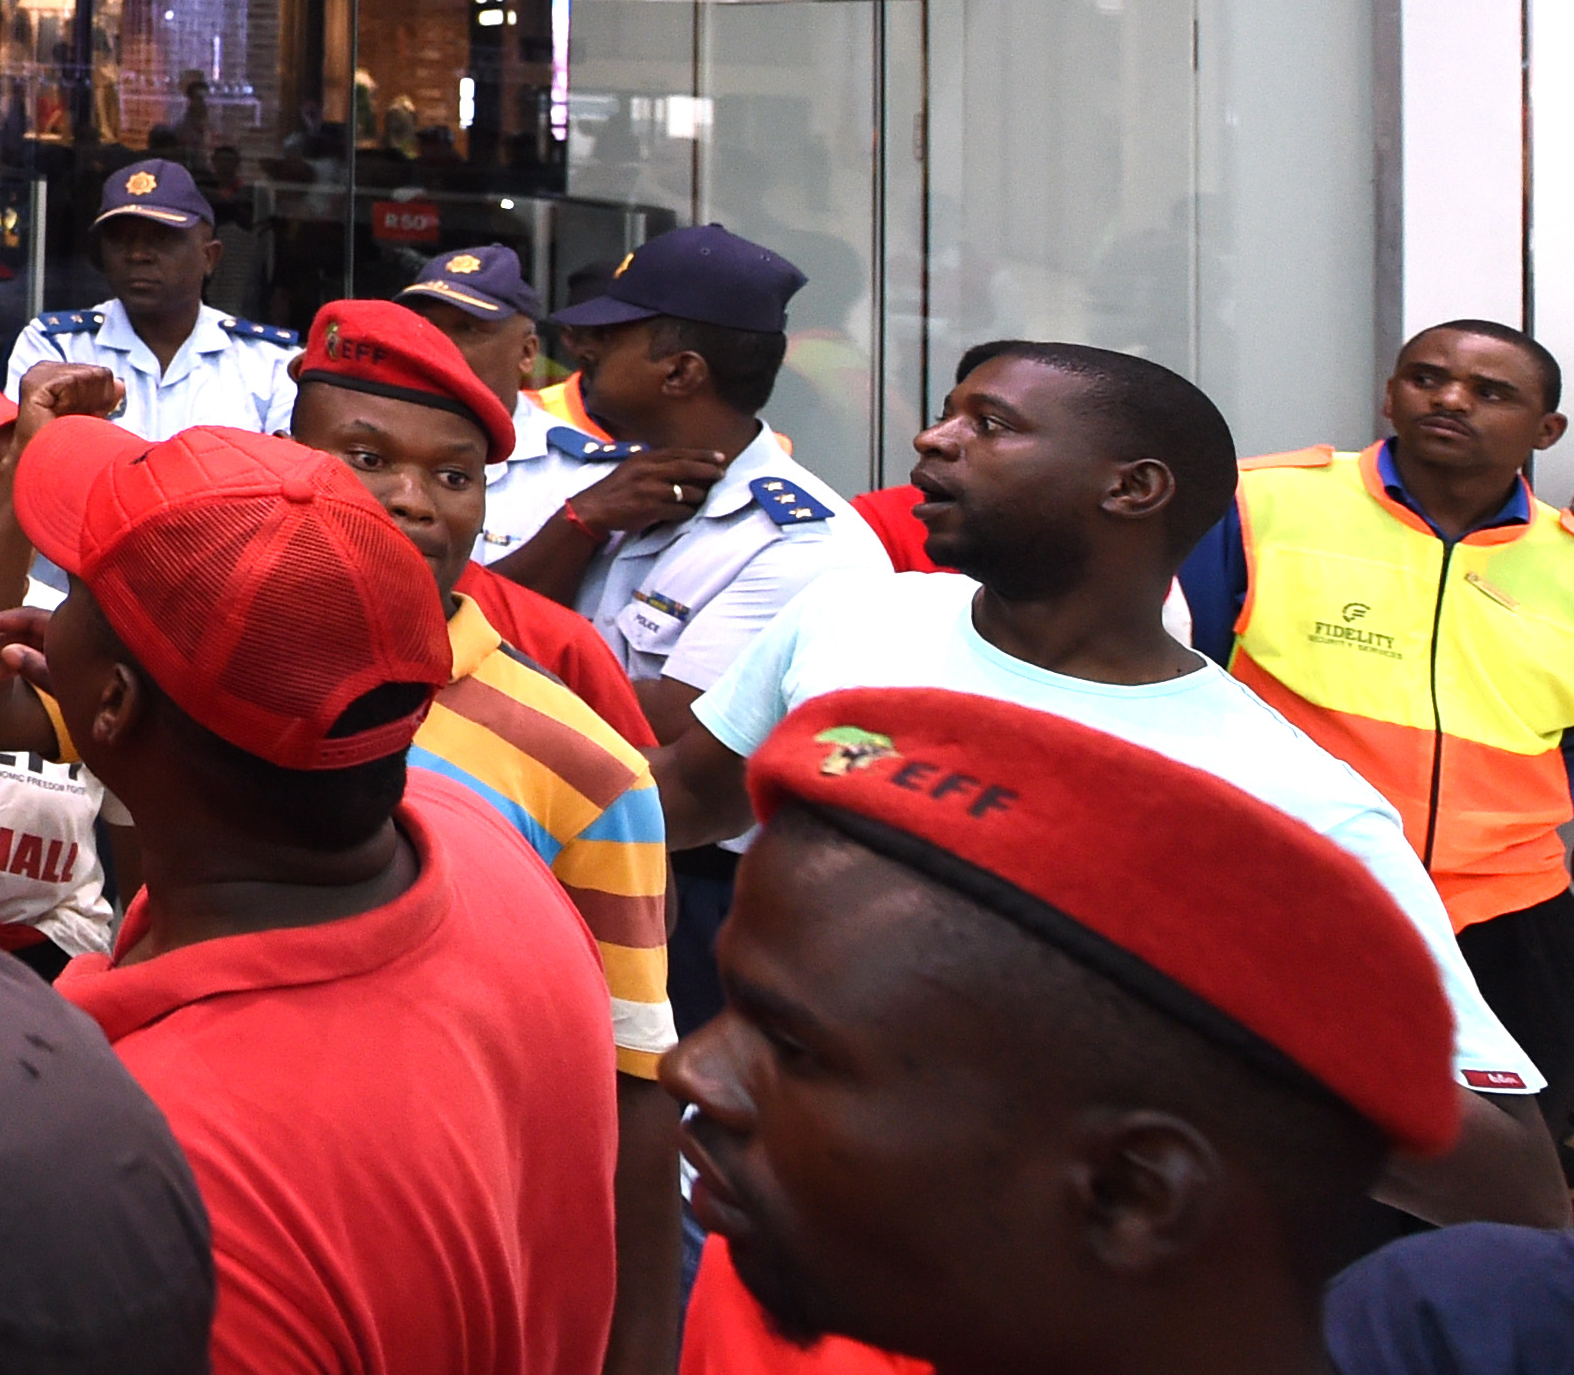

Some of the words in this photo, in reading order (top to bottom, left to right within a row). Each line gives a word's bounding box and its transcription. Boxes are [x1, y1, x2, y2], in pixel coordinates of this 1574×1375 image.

[342, 337, 389, 365] EFF
[1315, 621, 1394, 649] FIDELITY
[891, 761, 1020, 818] EFF
